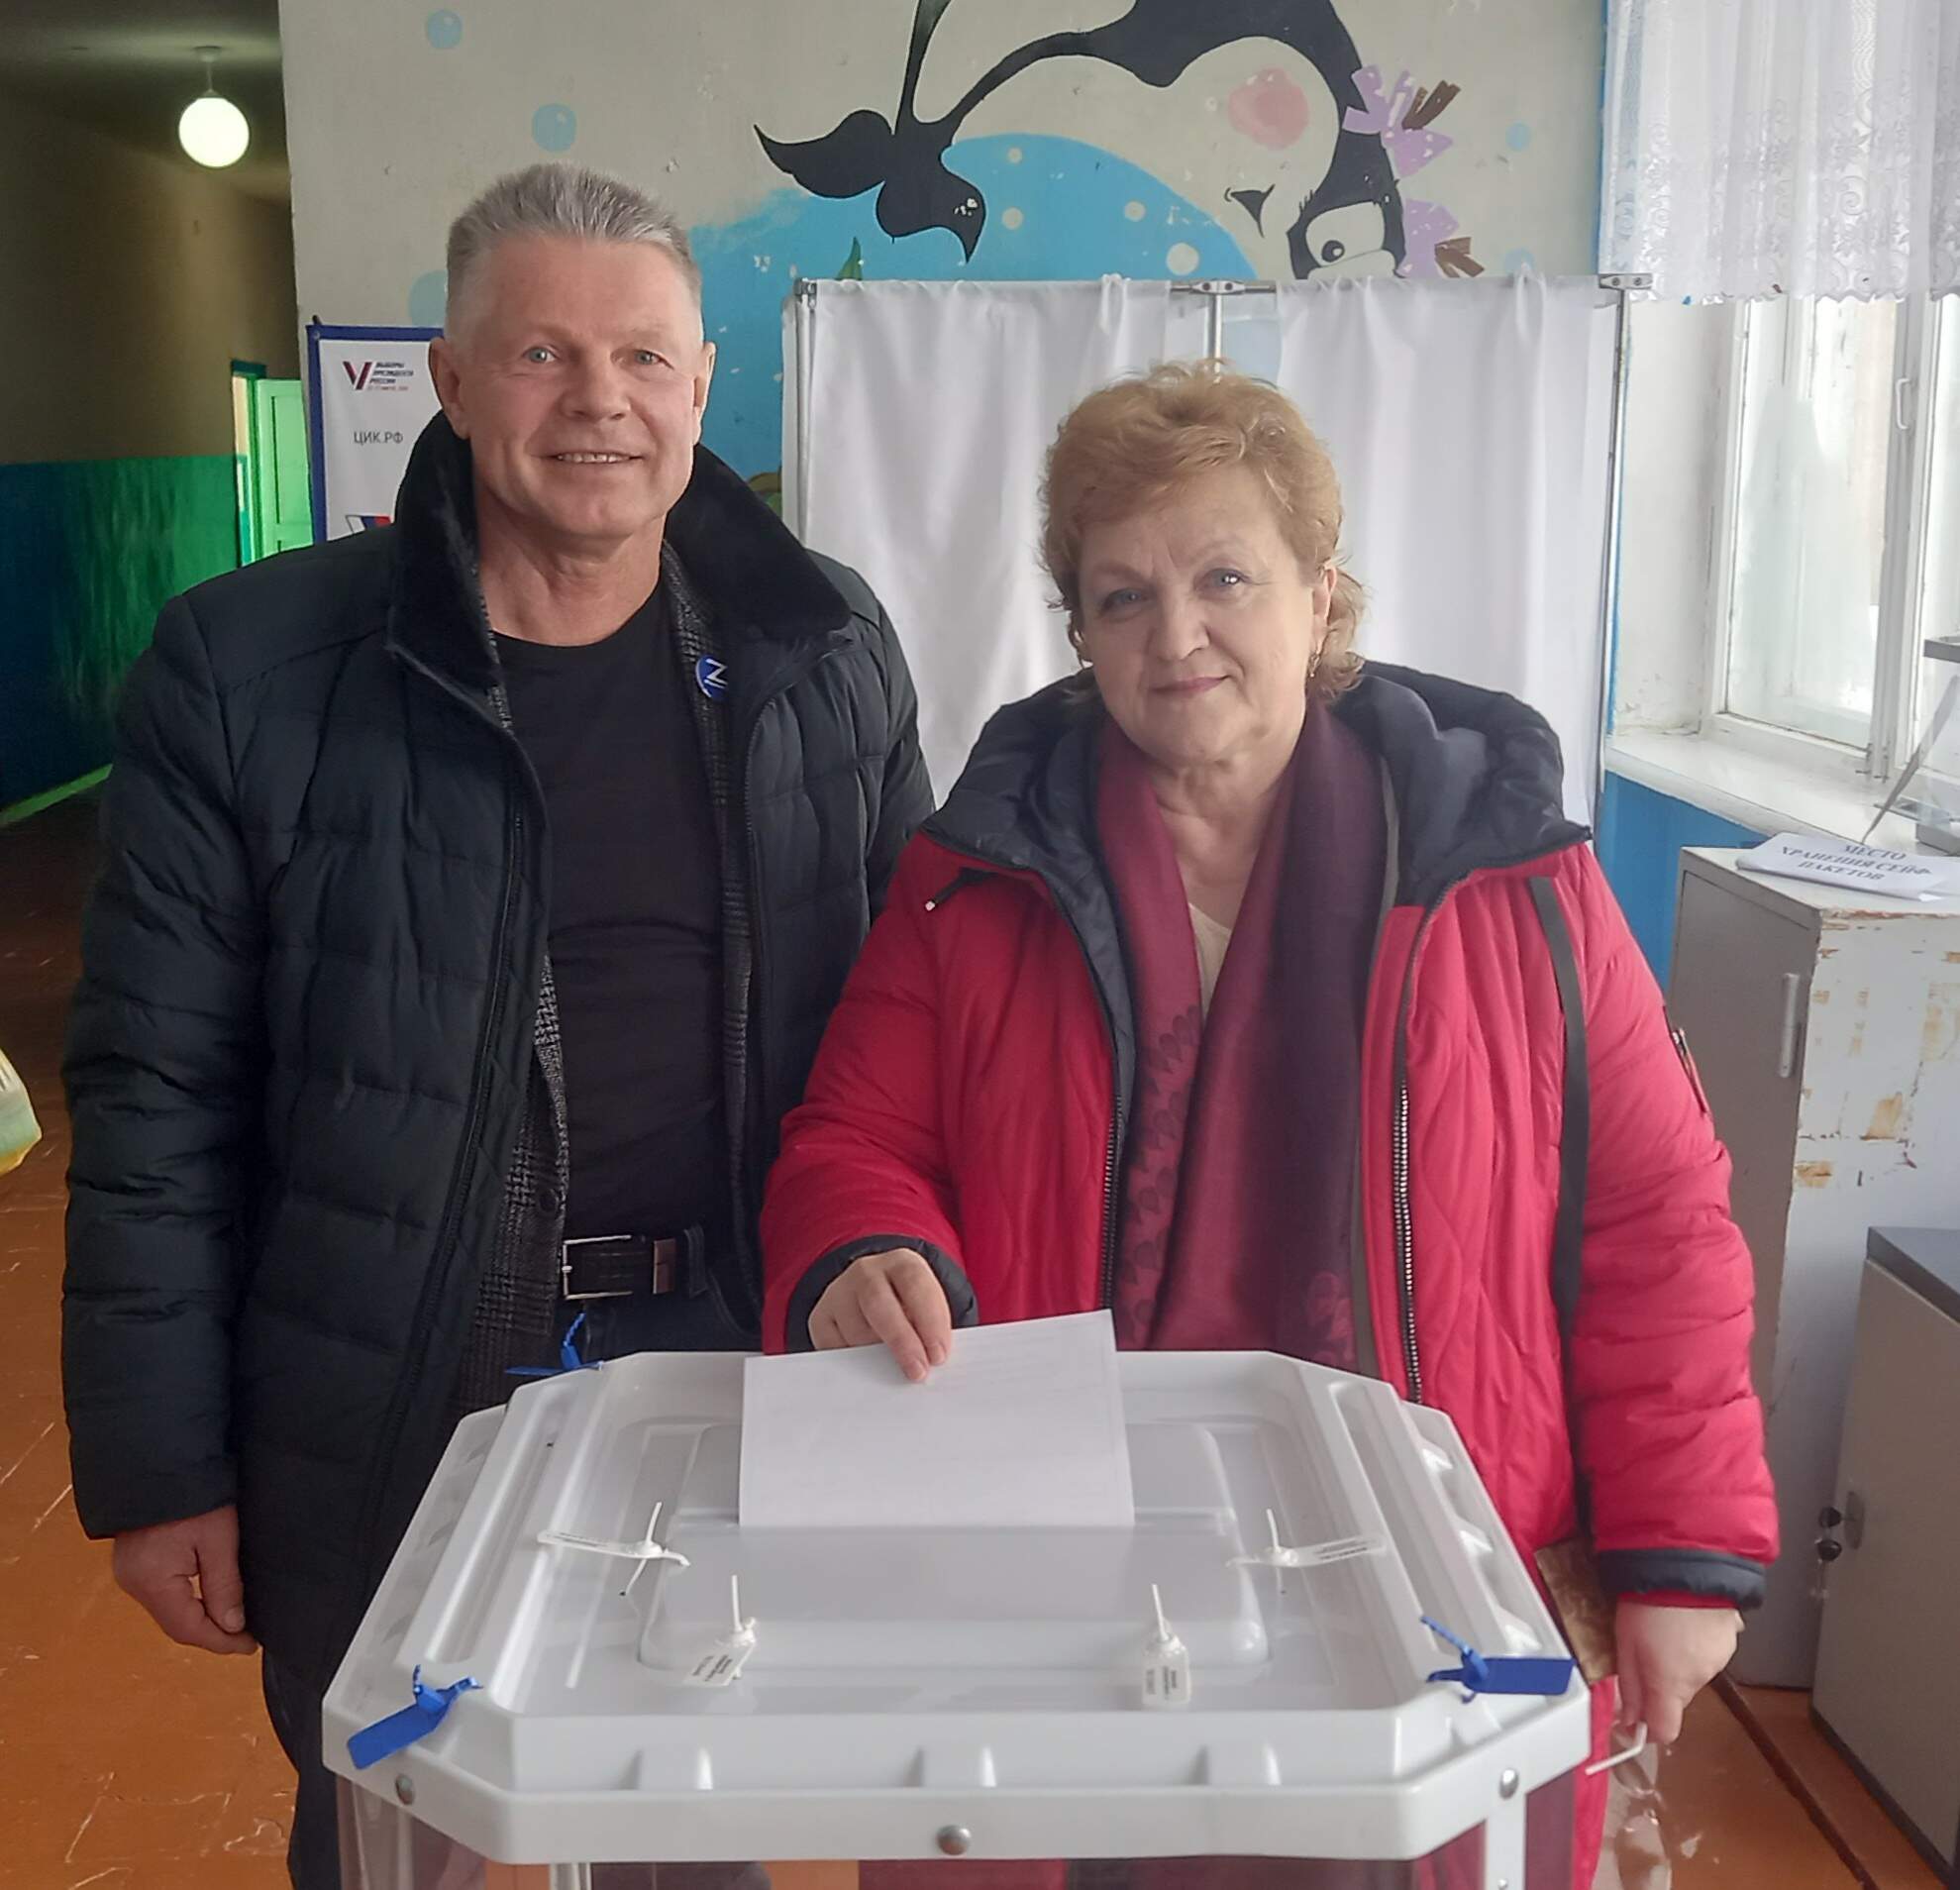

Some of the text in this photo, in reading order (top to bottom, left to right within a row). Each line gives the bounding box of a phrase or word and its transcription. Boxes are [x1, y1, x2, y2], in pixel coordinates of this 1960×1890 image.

[354, 431, 404, 446] ЦИК.РФ
[1782, 846, 1876, 868] ХРАНЕНИЯ
[1845, 844, 1907, 860] МЕСТО
[1798, 860, 1886, 881] ПАКЕТОВ
